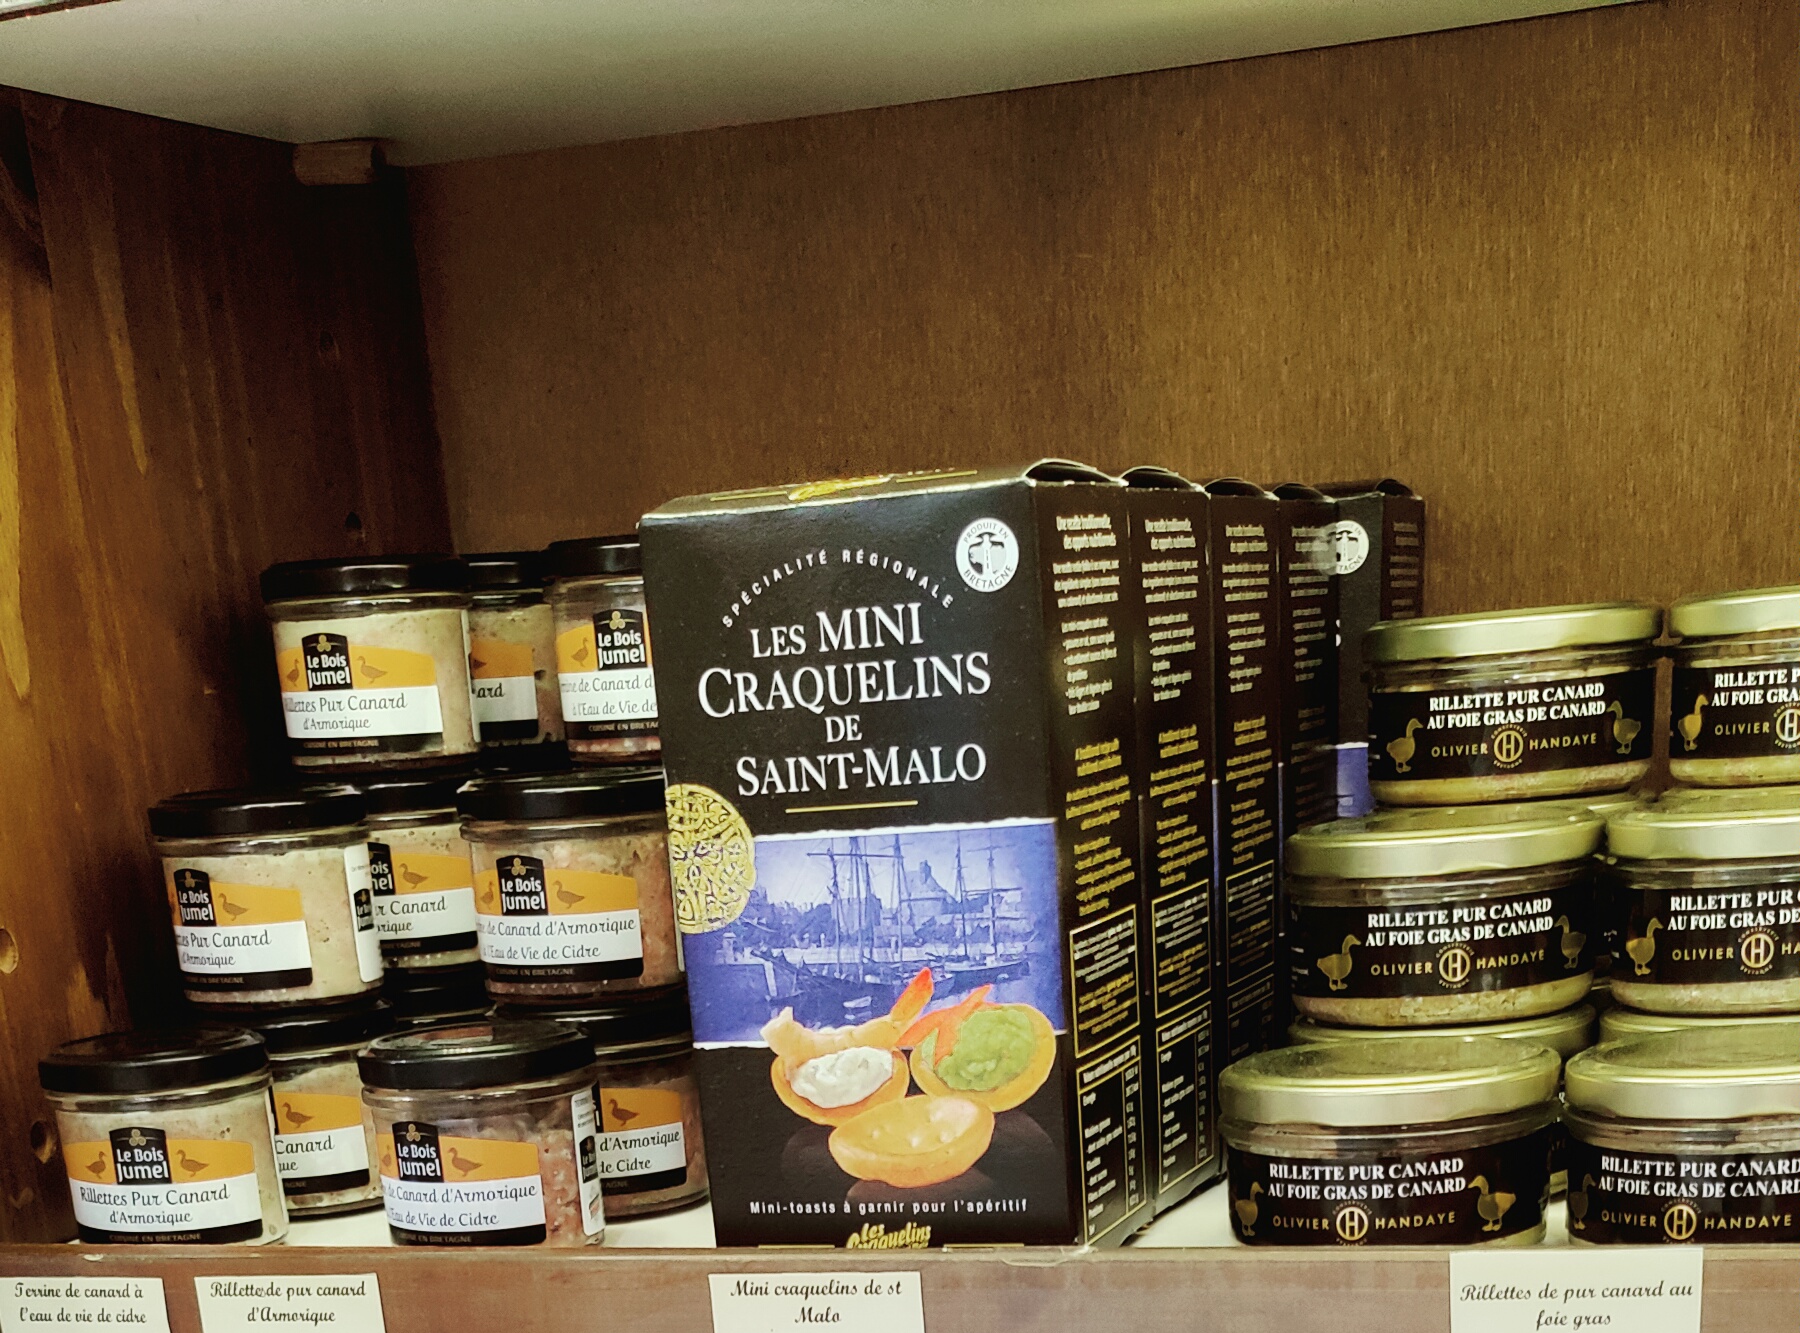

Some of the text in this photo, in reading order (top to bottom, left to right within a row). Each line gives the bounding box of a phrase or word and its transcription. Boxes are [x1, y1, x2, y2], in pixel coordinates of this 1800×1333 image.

[963, 522, 1009, 544] PRODUIT EN
[963, 565, 1013, 588] BRETAGNE
[722, 549, 954, 629] SPÉCIALITÉ RÉGIONALE
[614, 630, 642, 645] Bois
[751, 602, 923, 658] LES MINI
[307, 653, 346, 668] Le Bois
[599, 644, 645, 668] Jumel
[307, 667, 351, 687] Jumel
[592, 677, 640, 692] Canard
[698, 652, 990, 718] CRAQUELINS
[1714, 670, 1787, 689] RILLETTE
[319, 693, 407, 713] Pur Canard
[1507, 682, 1604, 706] PUR CANARD
[303, 716, 371, 733] d'Armorique
[825, 715, 862, 742] DE
[1714, 721, 1769, 736] OLIVIER
[1431, 732, 1597, 758] OLIVIER HANDAYE
[736, 743, 987, 797] SAINT-MALO
[515, 878, 542, 893] Bois
[180, 902, 214, 922] Jumel
[501, 892, 546, 912] Jumel
[1368, 898, 1552, 928] RILLETTE PUR CANARD
[497, 915, 636, 936] Canard d'Armorique
[189, 930, 272, 948] Pur Canard
[562, 943, 601, 959] Cidre
[600, 1129, 681, 1152] d'Armorique
[117, 1148, 164, 1162] Le Bois
[117, 1161, 169, 1182] Jumel
[399, 1158, 441, 1177] Jumel
[1270, 1158, 1463, 1181] RILLETTE PUR CANARD
[80, 1184, 230, 1206] Rillettes Pur Canard
[397, 1184, 538, 1204] Canard d'Armorique
[1268, 1177, 1466, 1200] AU FOIE GRAS DE CANARD
[459, 1208, 499, 1226] Cidre
[749, 1199, 1028, 1215] Mini-toasts à garnir pour l'apéritif
[110, 1211, 193, 1226] d'Armorique
[1273, 1212, 1456, 1230] OLIVIER HANDAYE
[14, 1282, 144, 1299] Terrine de canard à
[286, 1281, 366, 1300] pur canard
[730, 1279, 902, 1300] Mini craquelins de st
[1460, 1280, 1693, 1304] Rillettes de pur canard au
[20, 1308, 147, 1323] l'eau de vie de cidre
[247, 1307, 336, 1326] d'Armorique
[795, 1307, 841, 1323] Malo
[1536, 1309, 1611, 1330] foie gras
